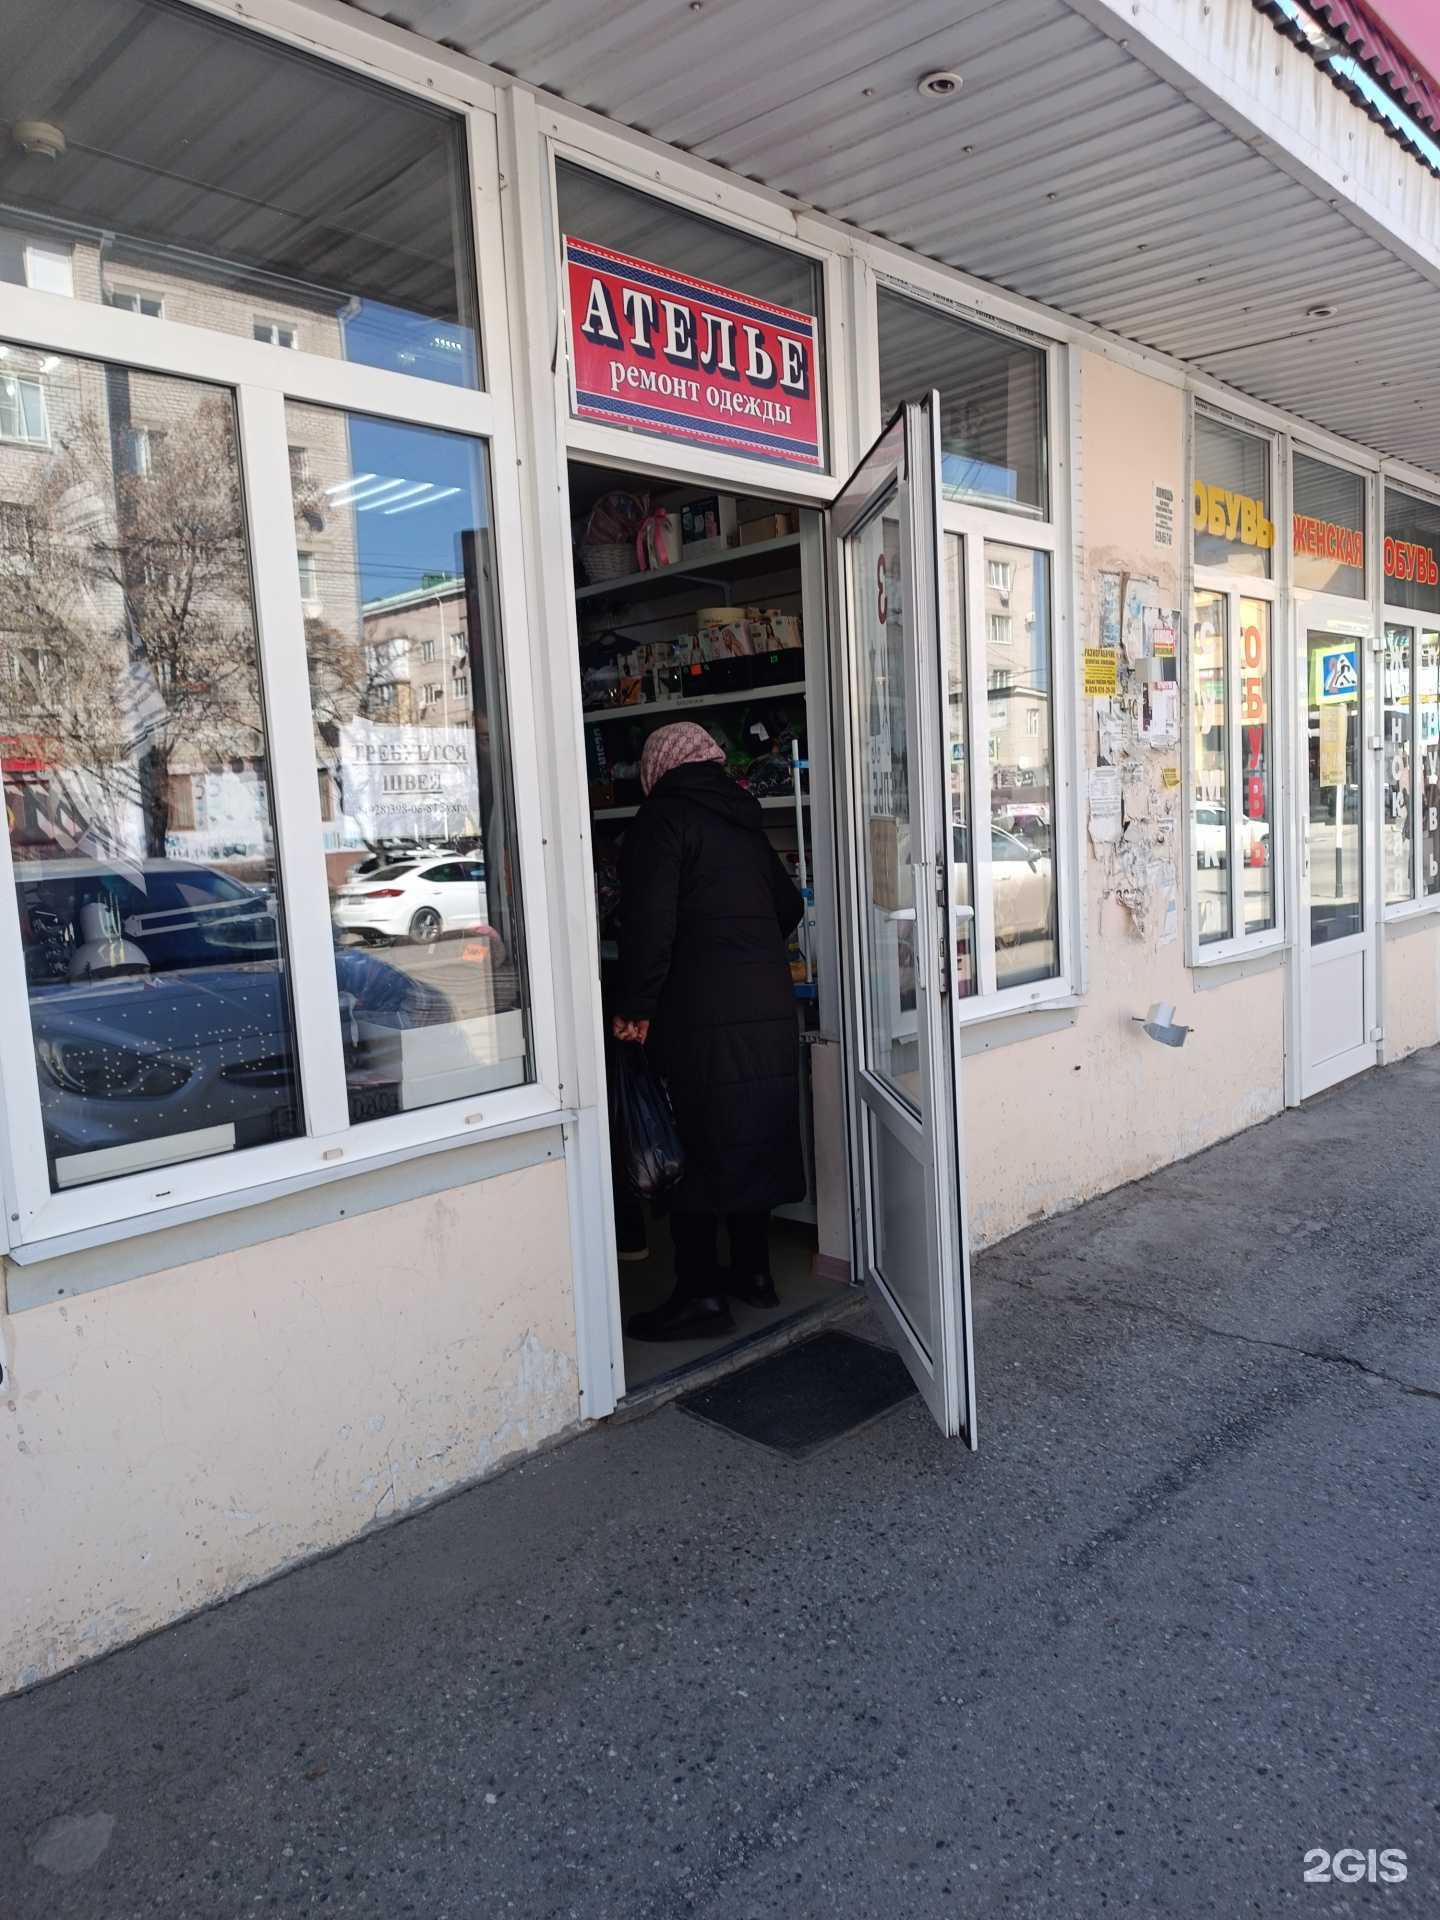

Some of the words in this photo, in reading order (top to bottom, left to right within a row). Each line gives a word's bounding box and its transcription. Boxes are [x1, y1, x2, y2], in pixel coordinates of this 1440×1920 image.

[580, 278, 807, 394] АТЕЛЬЕ
[609, 360, 700, 402] ремонт
[706, 386, 792, 425] одежды
[1193, 479, 1276, 549] ОБУВЬ
[1294, 512, 1364, 569] ЖЕНСКАЯ
[1384, 536, 1439, 586] ОБУВЬ
[1244, 625, 1265, 868] ОБУВЬ
